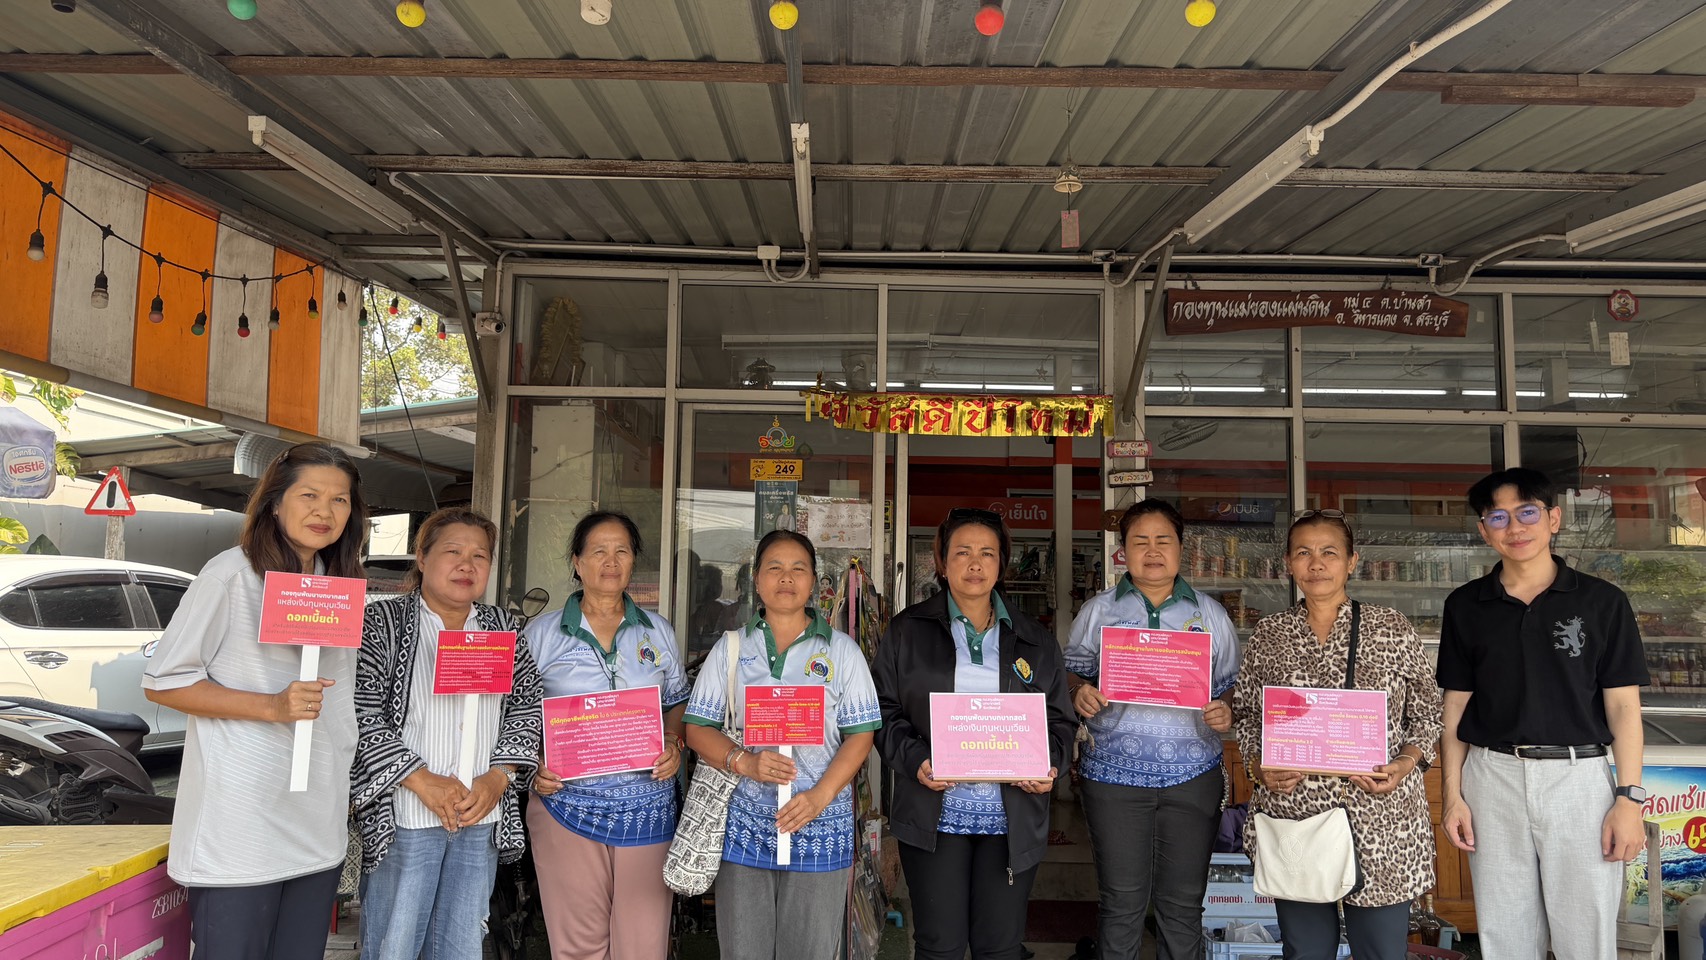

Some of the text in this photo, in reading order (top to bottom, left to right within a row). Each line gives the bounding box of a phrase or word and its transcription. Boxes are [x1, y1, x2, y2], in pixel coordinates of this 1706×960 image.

[1171, 293, 1331, 330] กองทุนแม่ของแผ่นดิน
[1352, 309, 1397, 327] วิหารแดง
[1415, 310, 1451, 333] สระบุรี
[775, 464, 796, 475] 249
[1009, 503, 1048, 521] เย็นใจ
[286, 609, 340, 625] ดอกเบี้ยต่ำ
[960, 735, 1020, 750] ดอกเบี้ยต่ำ
